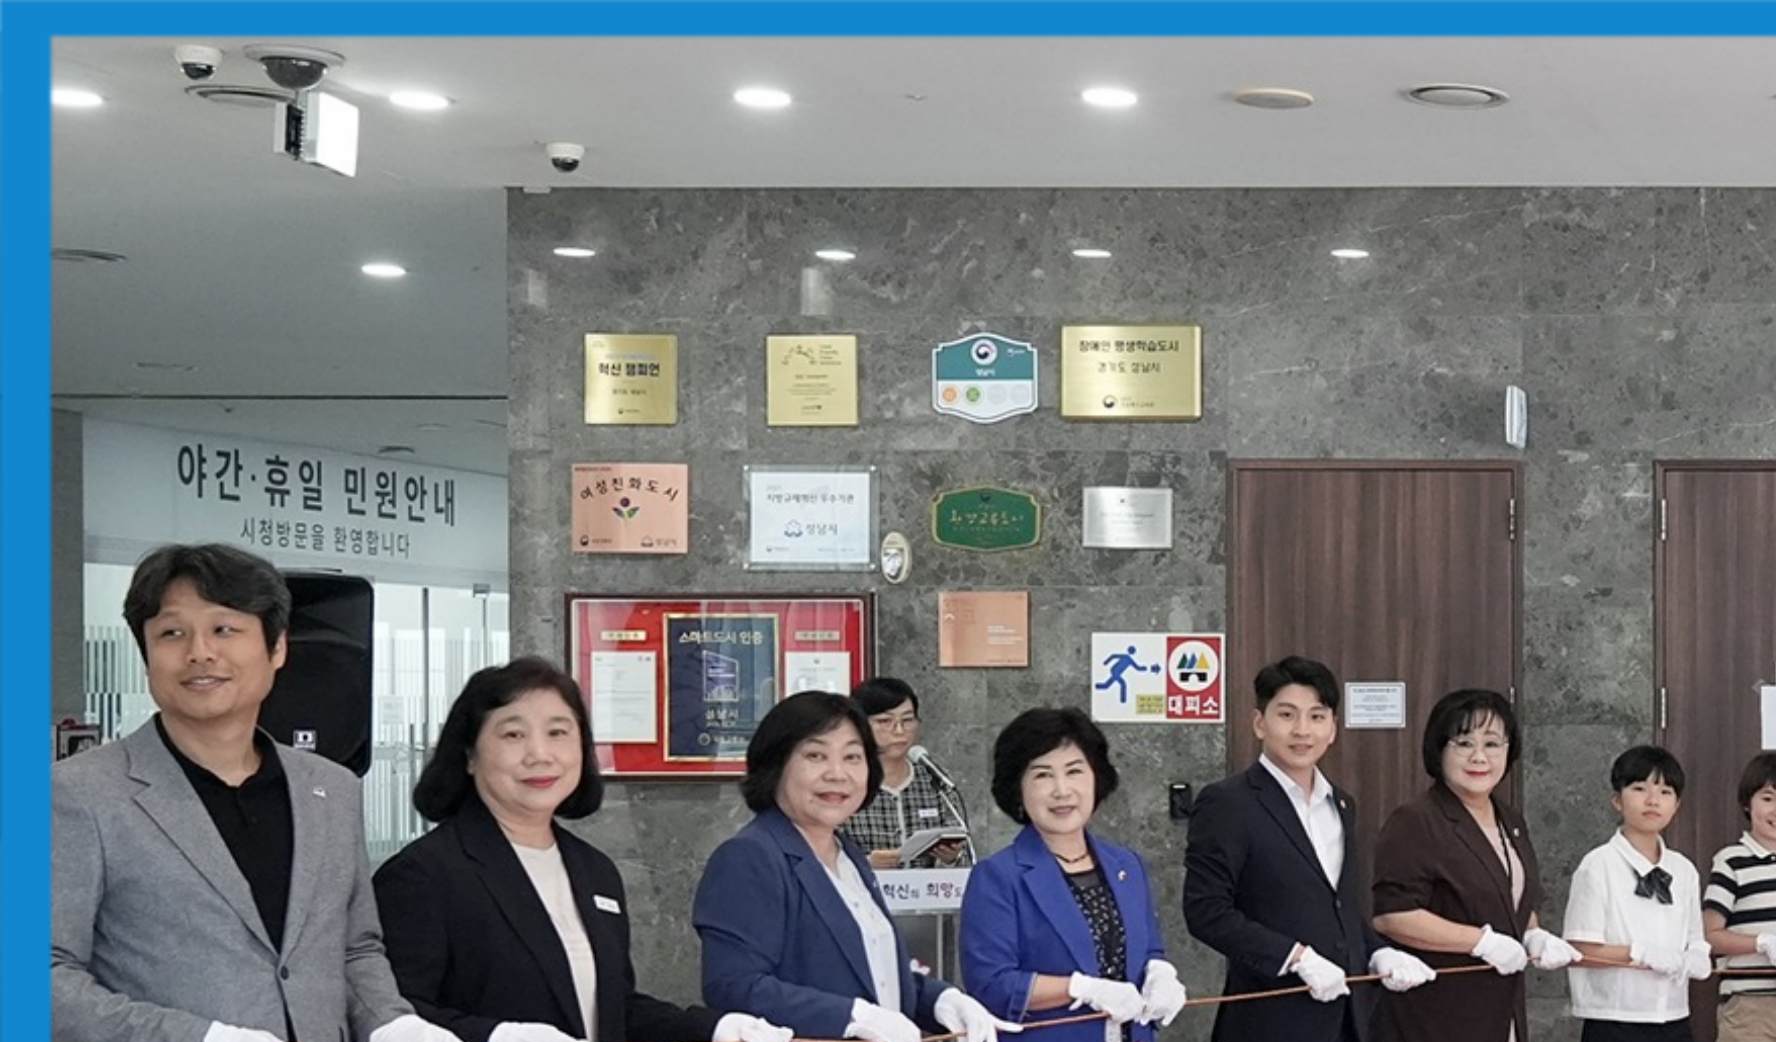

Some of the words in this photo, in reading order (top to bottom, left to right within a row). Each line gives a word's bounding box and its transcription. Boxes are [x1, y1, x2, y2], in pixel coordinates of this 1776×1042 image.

[1079, 340, 1111, 352] 장애인
[1114, 340, 1180, 352] 평생학습도시
[599, 362, 621, 376] 혁신
[1131, 361, 1161, 373] 성남시
[178, 443, 324, 512] 야간·휴일
[344, 467, 455, 527] 민원안내
[580, 477, 679, 502] 여성친화도시
[806, 523, 838, 536] 성남시
[240, 517, 325, 551] 시청방문을
[333, 526, 411, 558] 환영합니다
[679, 630, 737, 644] 스마트도시
[740, 631, 763, 645] 인증
[1168, 694, 1219, 715] 대피소
